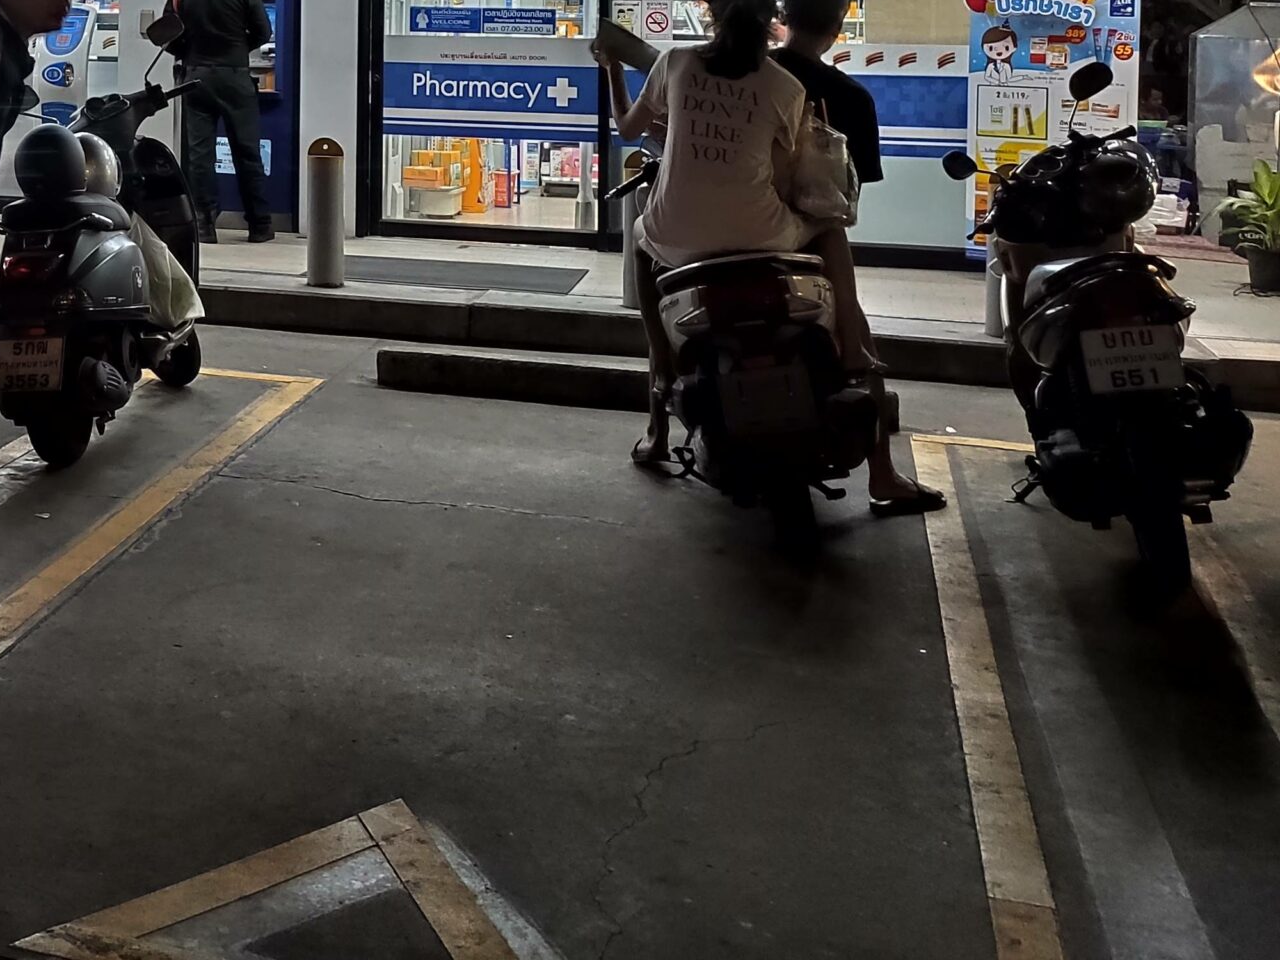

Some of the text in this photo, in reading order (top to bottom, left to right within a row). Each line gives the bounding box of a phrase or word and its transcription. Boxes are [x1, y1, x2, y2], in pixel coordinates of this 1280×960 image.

[501, 25, 544, 33] 07.00-23.00
[1066, 28, 1086, 38] 389
[1115, 45, 1132, 56] 55
[412, 70, 542, 108] Pharmacy
[687, 73, 759, 107] MAMA
[682, 94, 754, 124] DON'T
[689, 119, 744, 145] LIKE
[689, 143, 738, 164] YOU
[4, 374, 50, 389] 3553
[1111, 368, 1159, 388] 651
